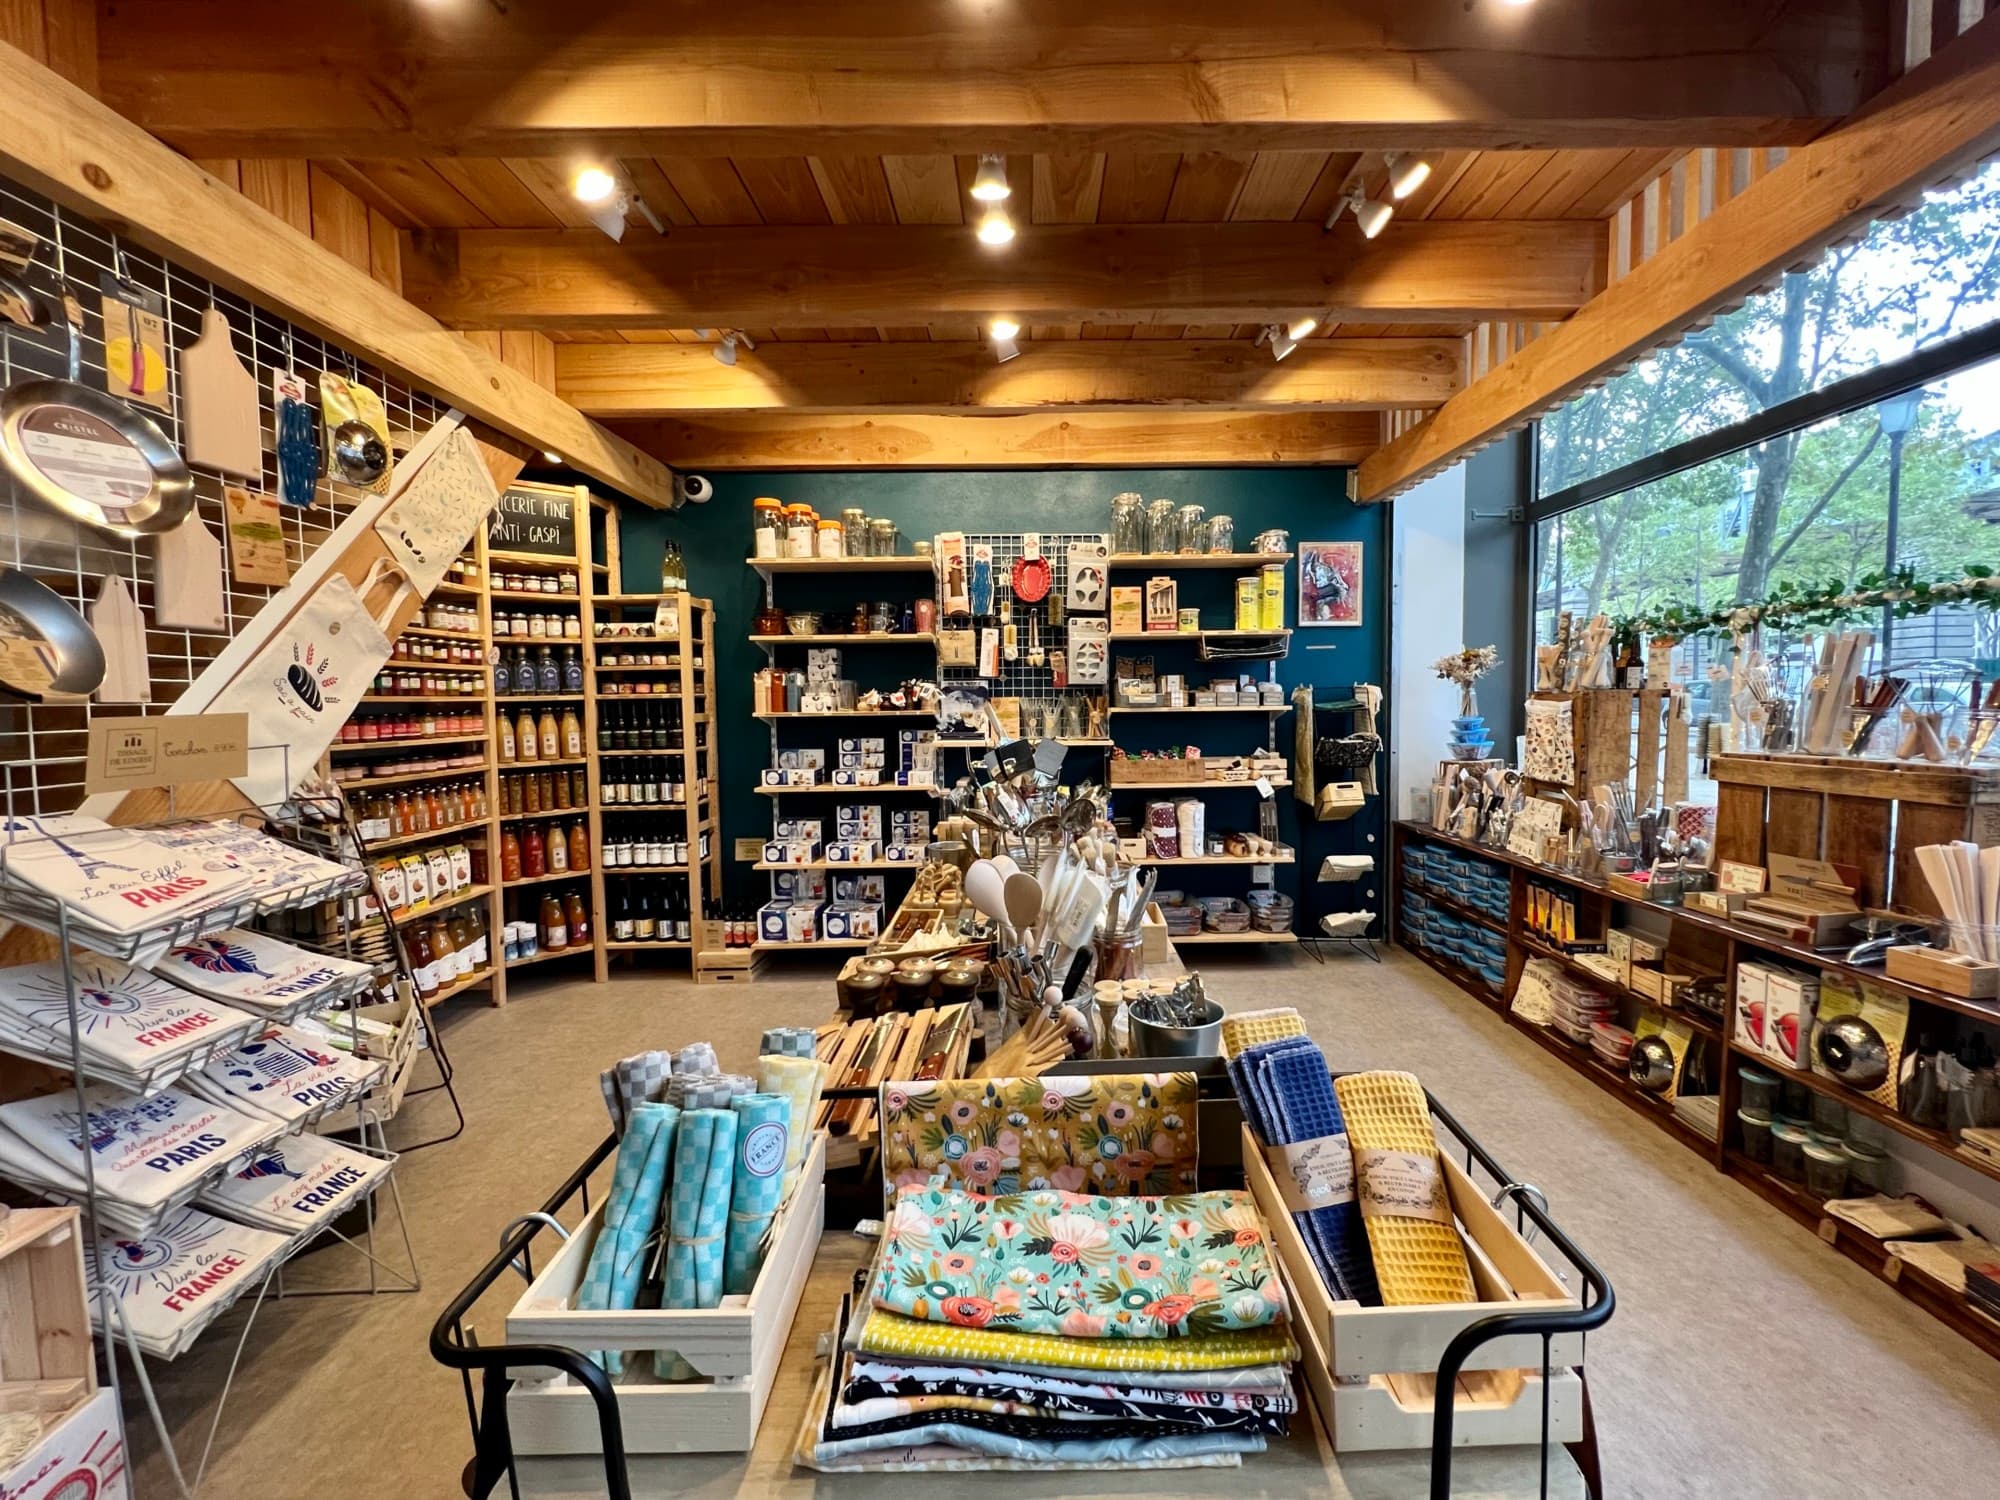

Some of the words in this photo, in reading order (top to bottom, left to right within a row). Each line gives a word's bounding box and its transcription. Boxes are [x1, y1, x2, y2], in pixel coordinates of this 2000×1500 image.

[53, 421, 99, 436] CRISTEL
[500, 496, 537, 515] ICERIE
[543, 499, 570, 520] FINE
[489, 522, 521, 542] ANTI
[529, 525, 560, 545] GASPI
[80, 886, 109, 901] La
[109, 881, 140, 892] tour
[140, 860, 187, 883] Eiffel
[120, 876, 208, 909] PARIS
[263, 967, 344, 997] FRANCE
[120, 1015, 168, 1032] Vive
[166, 1008, 190, 1017] la
[134, 1012, 219, 1047] FRANCE
[292, 1076, 353, 1106] PARIS
[145, 1133, 227, 1173] PARIS
[751, 1135, 780, 1163] FRANCE
[308, 1163, 336, 1183] made
[292, 1165, 368, 1213] FRANCE
[150, 1269, 197, 1293] Vive
[195, 1251, 219, 1266] la
[162, 1255, 246, 1313] FRANCE
